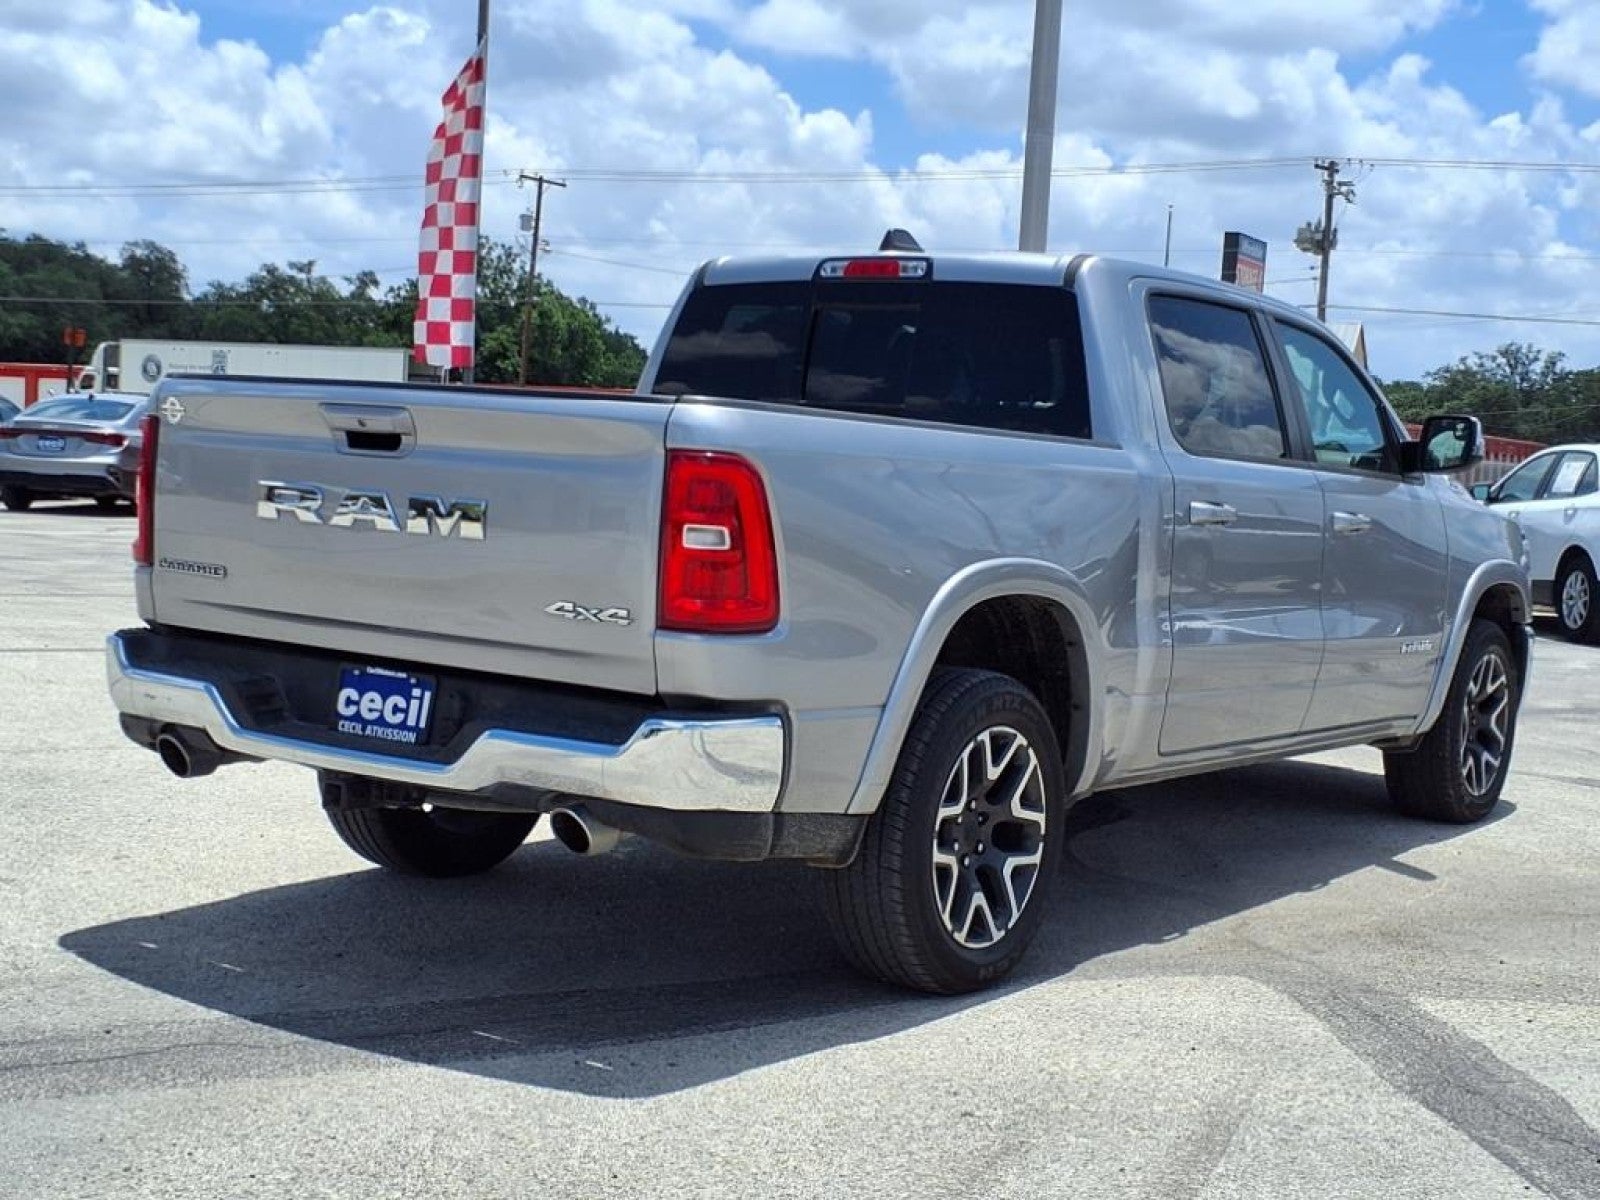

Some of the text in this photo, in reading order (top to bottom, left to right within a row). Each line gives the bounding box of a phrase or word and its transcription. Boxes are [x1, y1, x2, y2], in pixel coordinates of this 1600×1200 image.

[256, 480, 488, 540] RAM
[543, 600, 632, 627] 4x4
[337, 688, 432, 729] cecil
